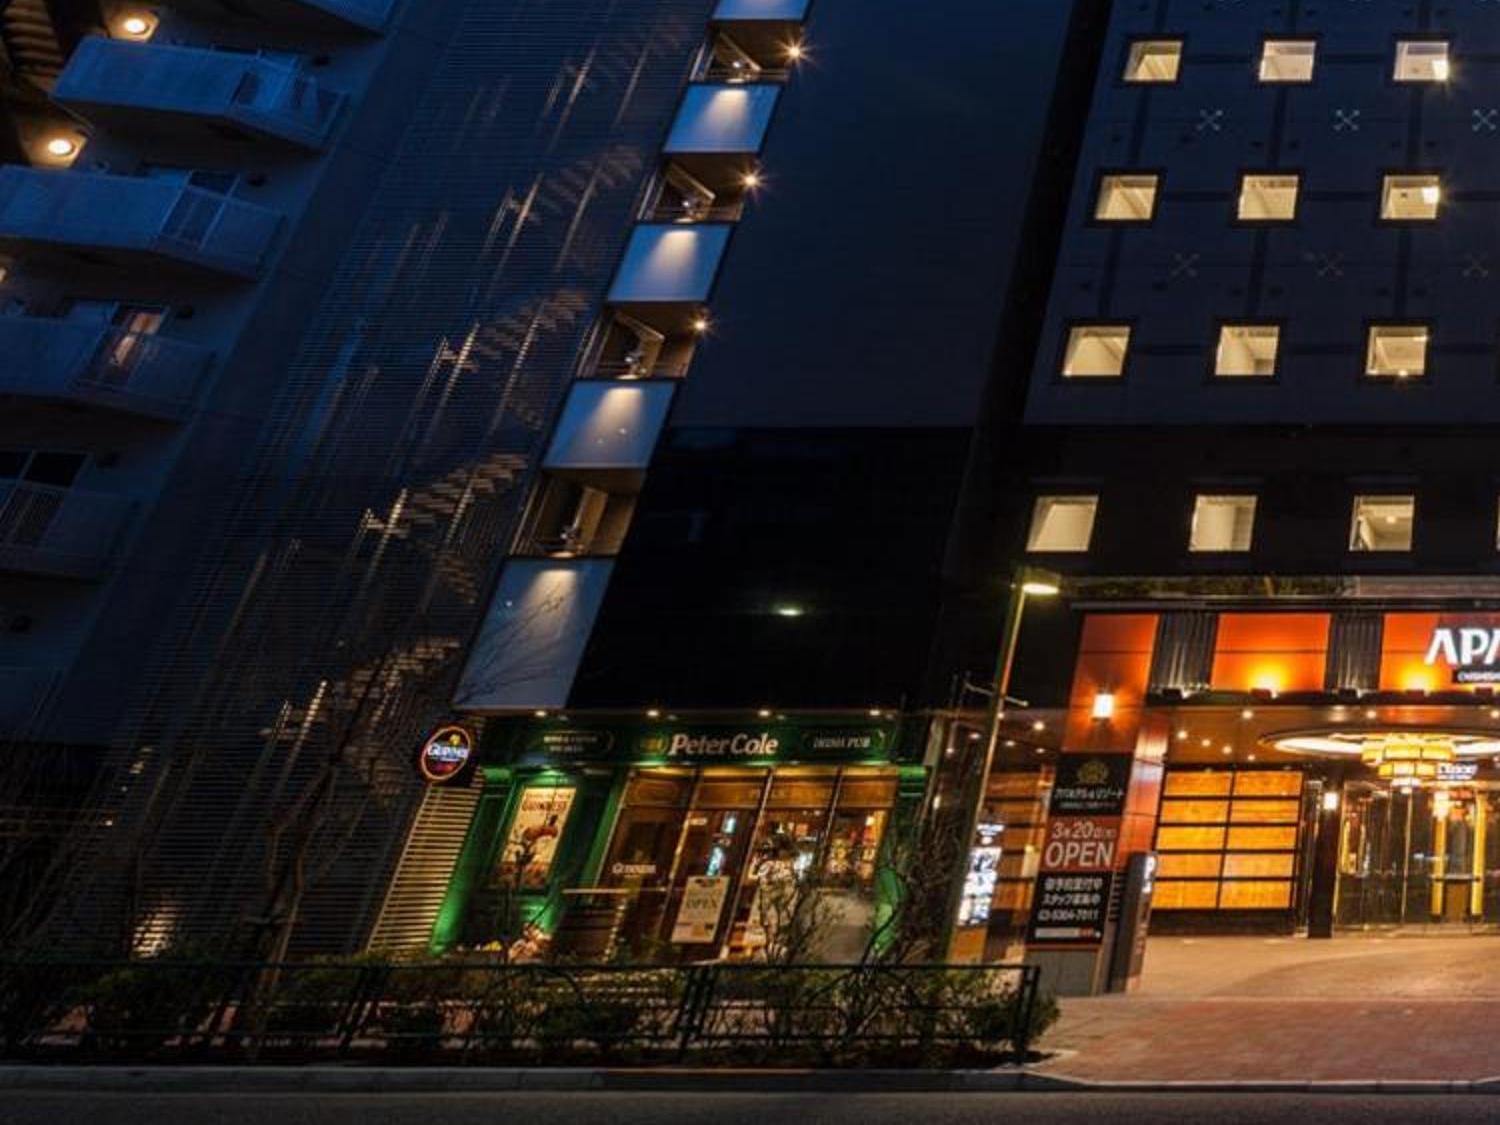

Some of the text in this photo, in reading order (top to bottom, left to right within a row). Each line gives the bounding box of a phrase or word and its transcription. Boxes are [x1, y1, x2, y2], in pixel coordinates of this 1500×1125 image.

[668, 732, 779, 756] Peter Cole
[1045, 841, 1115, 868] OPEN
